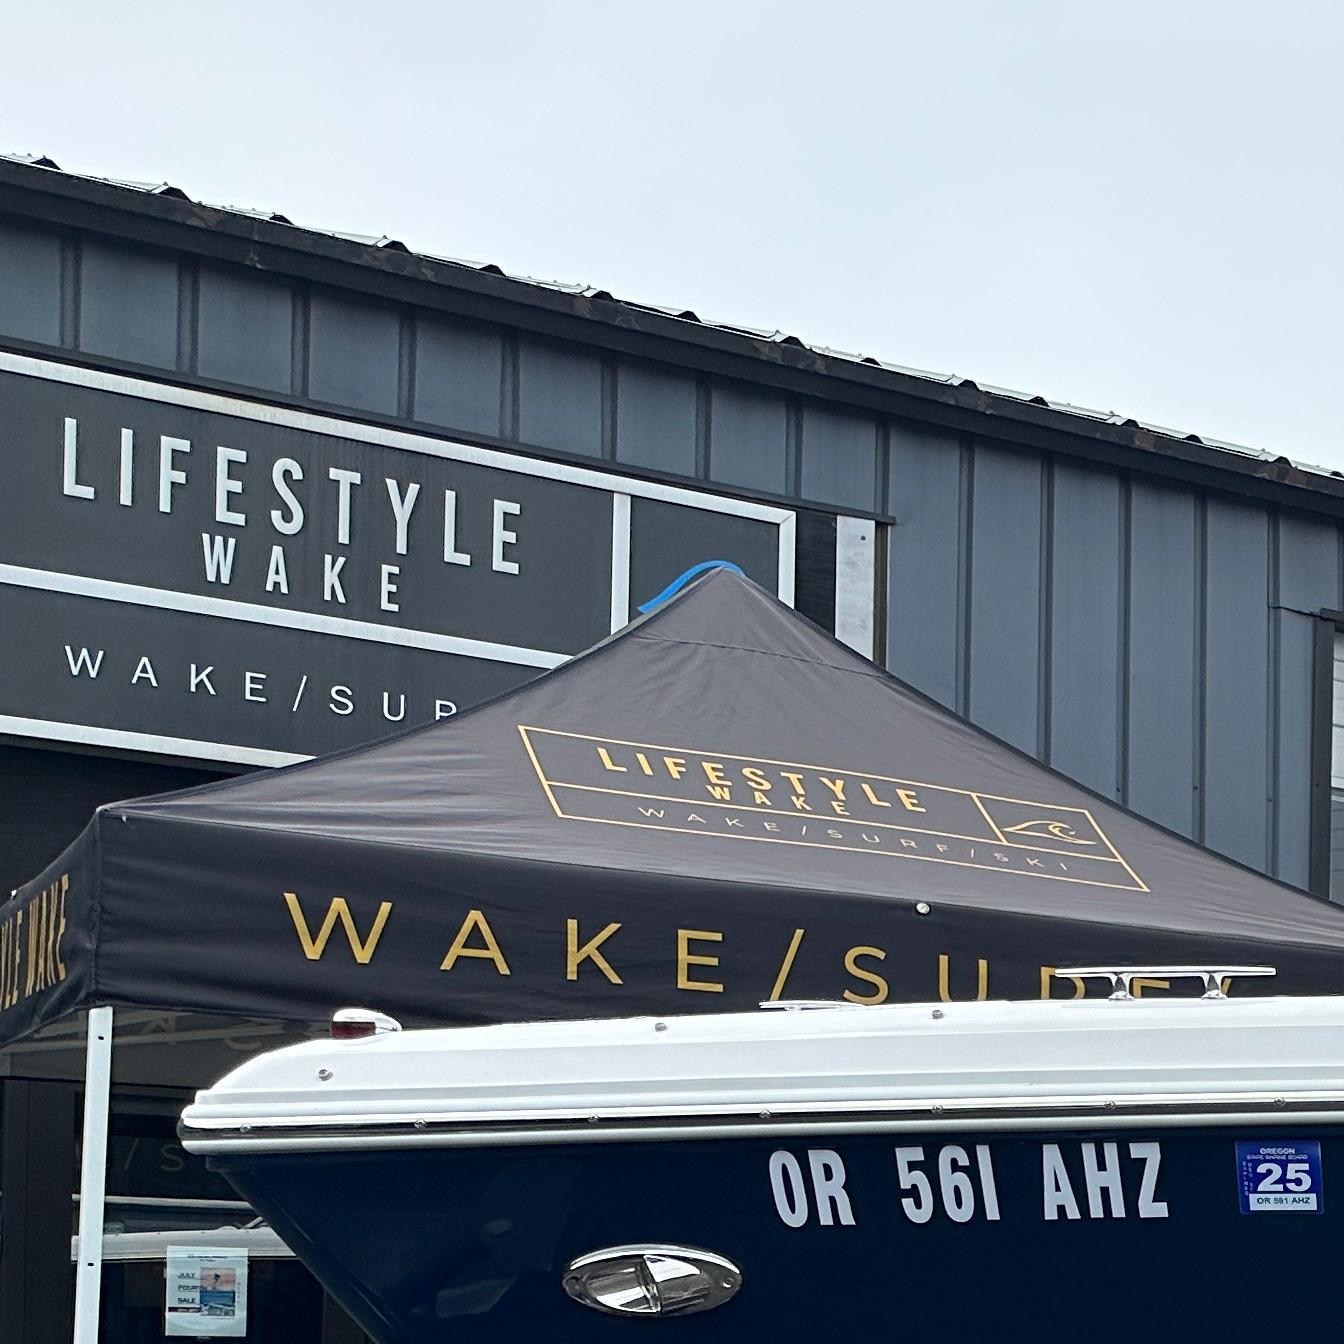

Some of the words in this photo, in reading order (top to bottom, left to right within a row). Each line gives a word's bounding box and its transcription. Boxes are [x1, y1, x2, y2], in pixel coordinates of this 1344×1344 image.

[63, 417, 521, 575] LIFESTYLE
[202, 533, 400, 612] WAKE
[597, 747, 926, 813] LIFESTYLE
[705, 784, 850, 816] WAKE
[25, 873, 69, 998] WAKE
[1256, 1162, 1312, 1193] 25
[1260, 1147, 1296, 1155] OREGON
[769, 1149, 857, 1228] OR
[895, 1144, 1000, 1224] 561
[1042, 1142, 1169, 1221] AHZ
[1257, 1197, 1271, 1205] OR
[1291, 1197, 1311, 1205] AHZ
